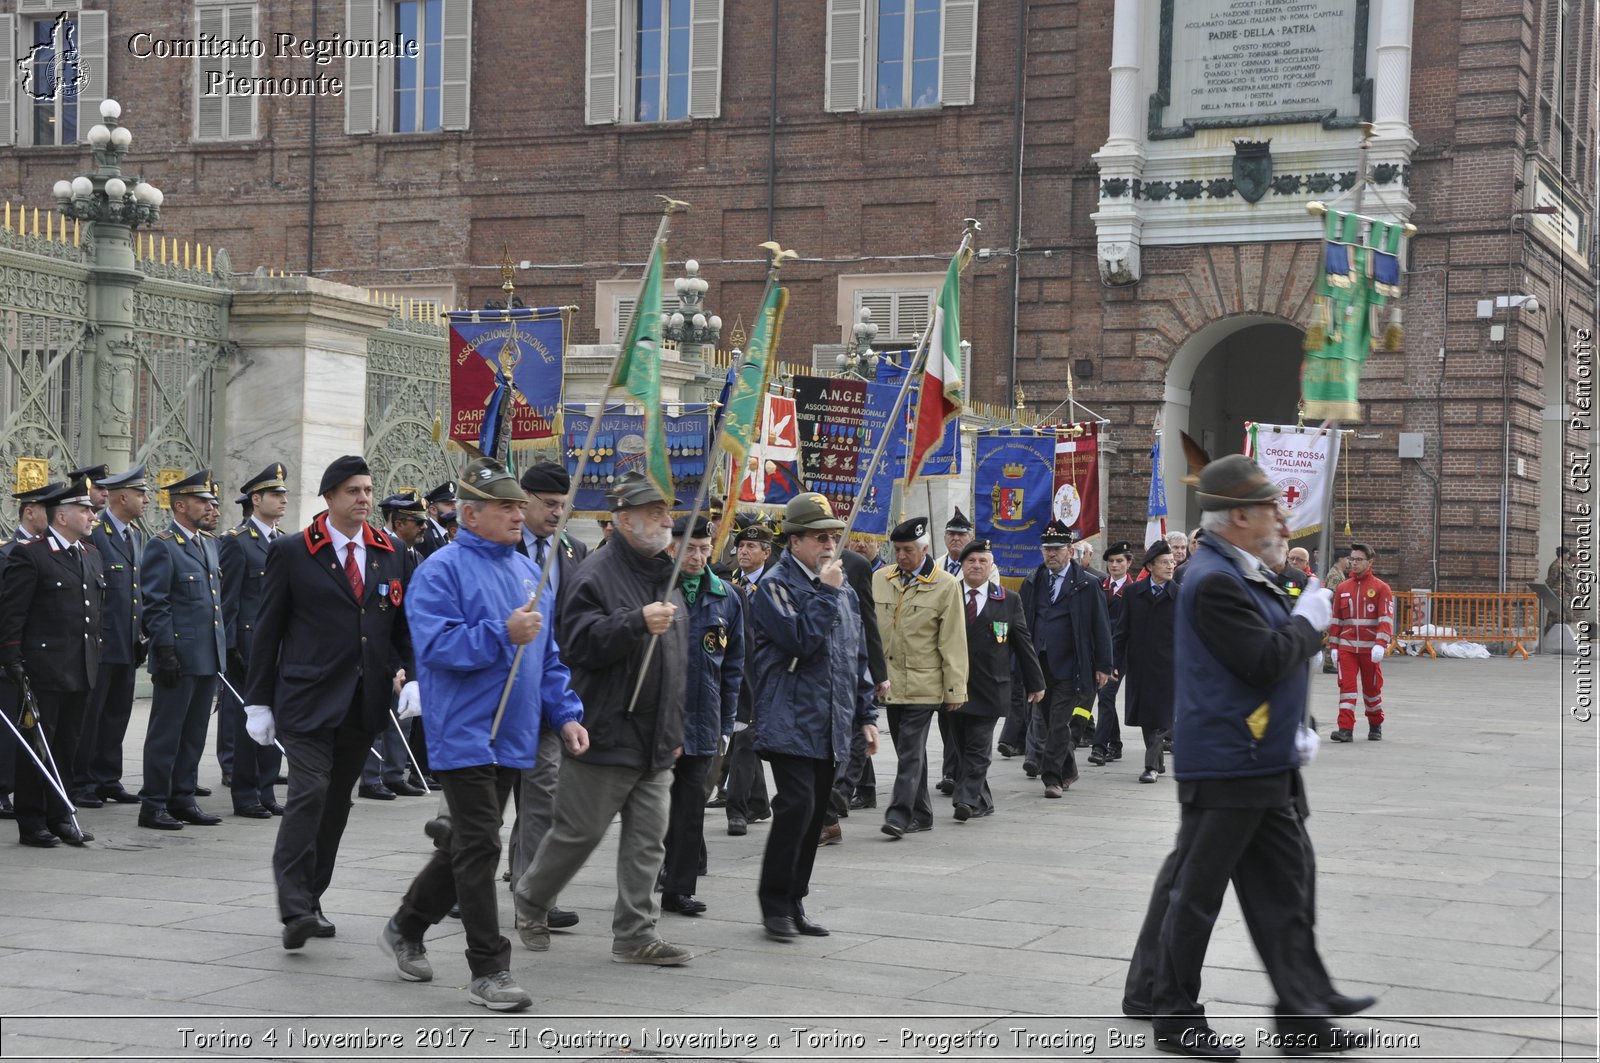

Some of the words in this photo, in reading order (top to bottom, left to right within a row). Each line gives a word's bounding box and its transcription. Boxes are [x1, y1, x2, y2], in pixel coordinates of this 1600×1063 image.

[1223, 9, 1250, 18] NAZIONE
[1287, 4, 1318, 12] COSTITVI
[1185, 20, 1224, 30] ACCLAMATO
[1227, 18, 1246, 26] DAGLI
[1250, 15, 1276, 24] ITALIANI
[1290, 13, 1310, 21] ROMA
[1313, 10, 1344, 19] CAPITALE
[1208, 30, 1238, 41] PADRE
[1243, 27, 1275, 38] DELLA
[1281, 24, 1316, 35] PATRIA
[1233, 43, 1259, 52] QVESTO
[1224, 61, 1238, 69] XXV
[1242, 58, 1271, 67] GENNAIO
[1204, 70, 1231, 79] QVANDO
[1261, 74, 1279, 82] VOTO
[1208, 86, 1228, 94] AVEVA
[1296, 79, 1333, 88] CONGIVNTI
[1250, 91, 1274, 100] DESTINI
[1201, 103, 1220, 111] DELLA
[1224, 101, 1246, 110] PATRIA
[1257, 99, 1277, 107] DELLA
[456, 328, 511, 366] ASSOCIAZIONE
[819, 389, 875, 405] A.N.G.E.T.
[804, 403, 850, 413] ASSOCIAZIONE
[851, 407, 887, 418] NAZIONALE
[517, 419, 553, 432] TORIN
[824, 415, 869, 427] TRASMETTITORI
[800, 440, 829, 449] EDAGLIE
[831, 443, 850, 451] ALLA
[1265, 448, 1294, 458] CROCE
[1297, 451, 1326, 460] ROSSA
[1275, 458, 1313, 468] ITALIANA
[803, 472, 833, 481] MEDAGLIE
